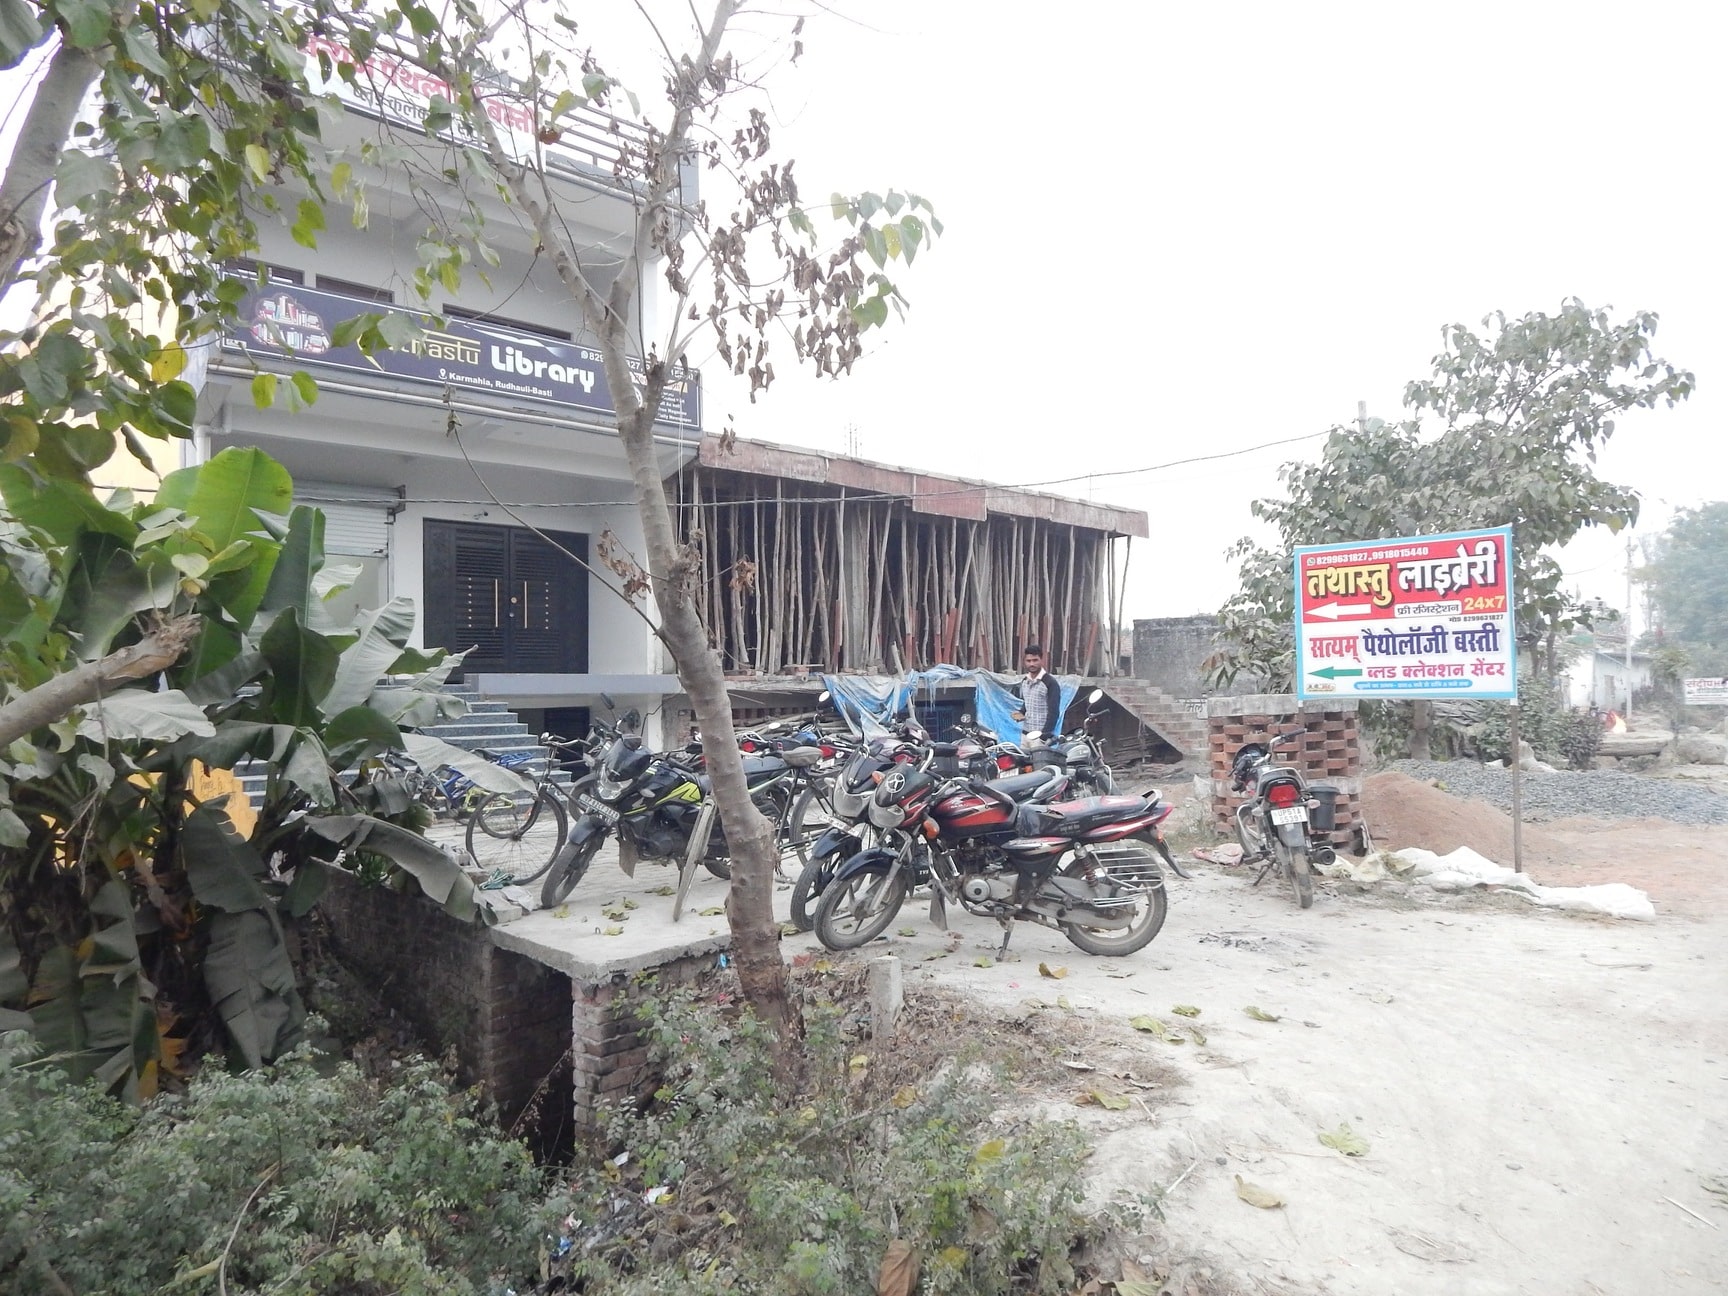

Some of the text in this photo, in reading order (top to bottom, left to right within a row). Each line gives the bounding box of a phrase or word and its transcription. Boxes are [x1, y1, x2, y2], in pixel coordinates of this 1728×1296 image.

[490, 345, 595, 393] Library
[1306, 540, 1497, 606] तथास्तु लाइब्रेरी
[1464, 595, 1505, 611] 24x7
[1309, 623, 1501, 663] सत्यम् पैथोलॉजी बस्ती
[1367, 666, 1397, 678] ब्लड
[1471, 658, 1506, 676] सेंटर
